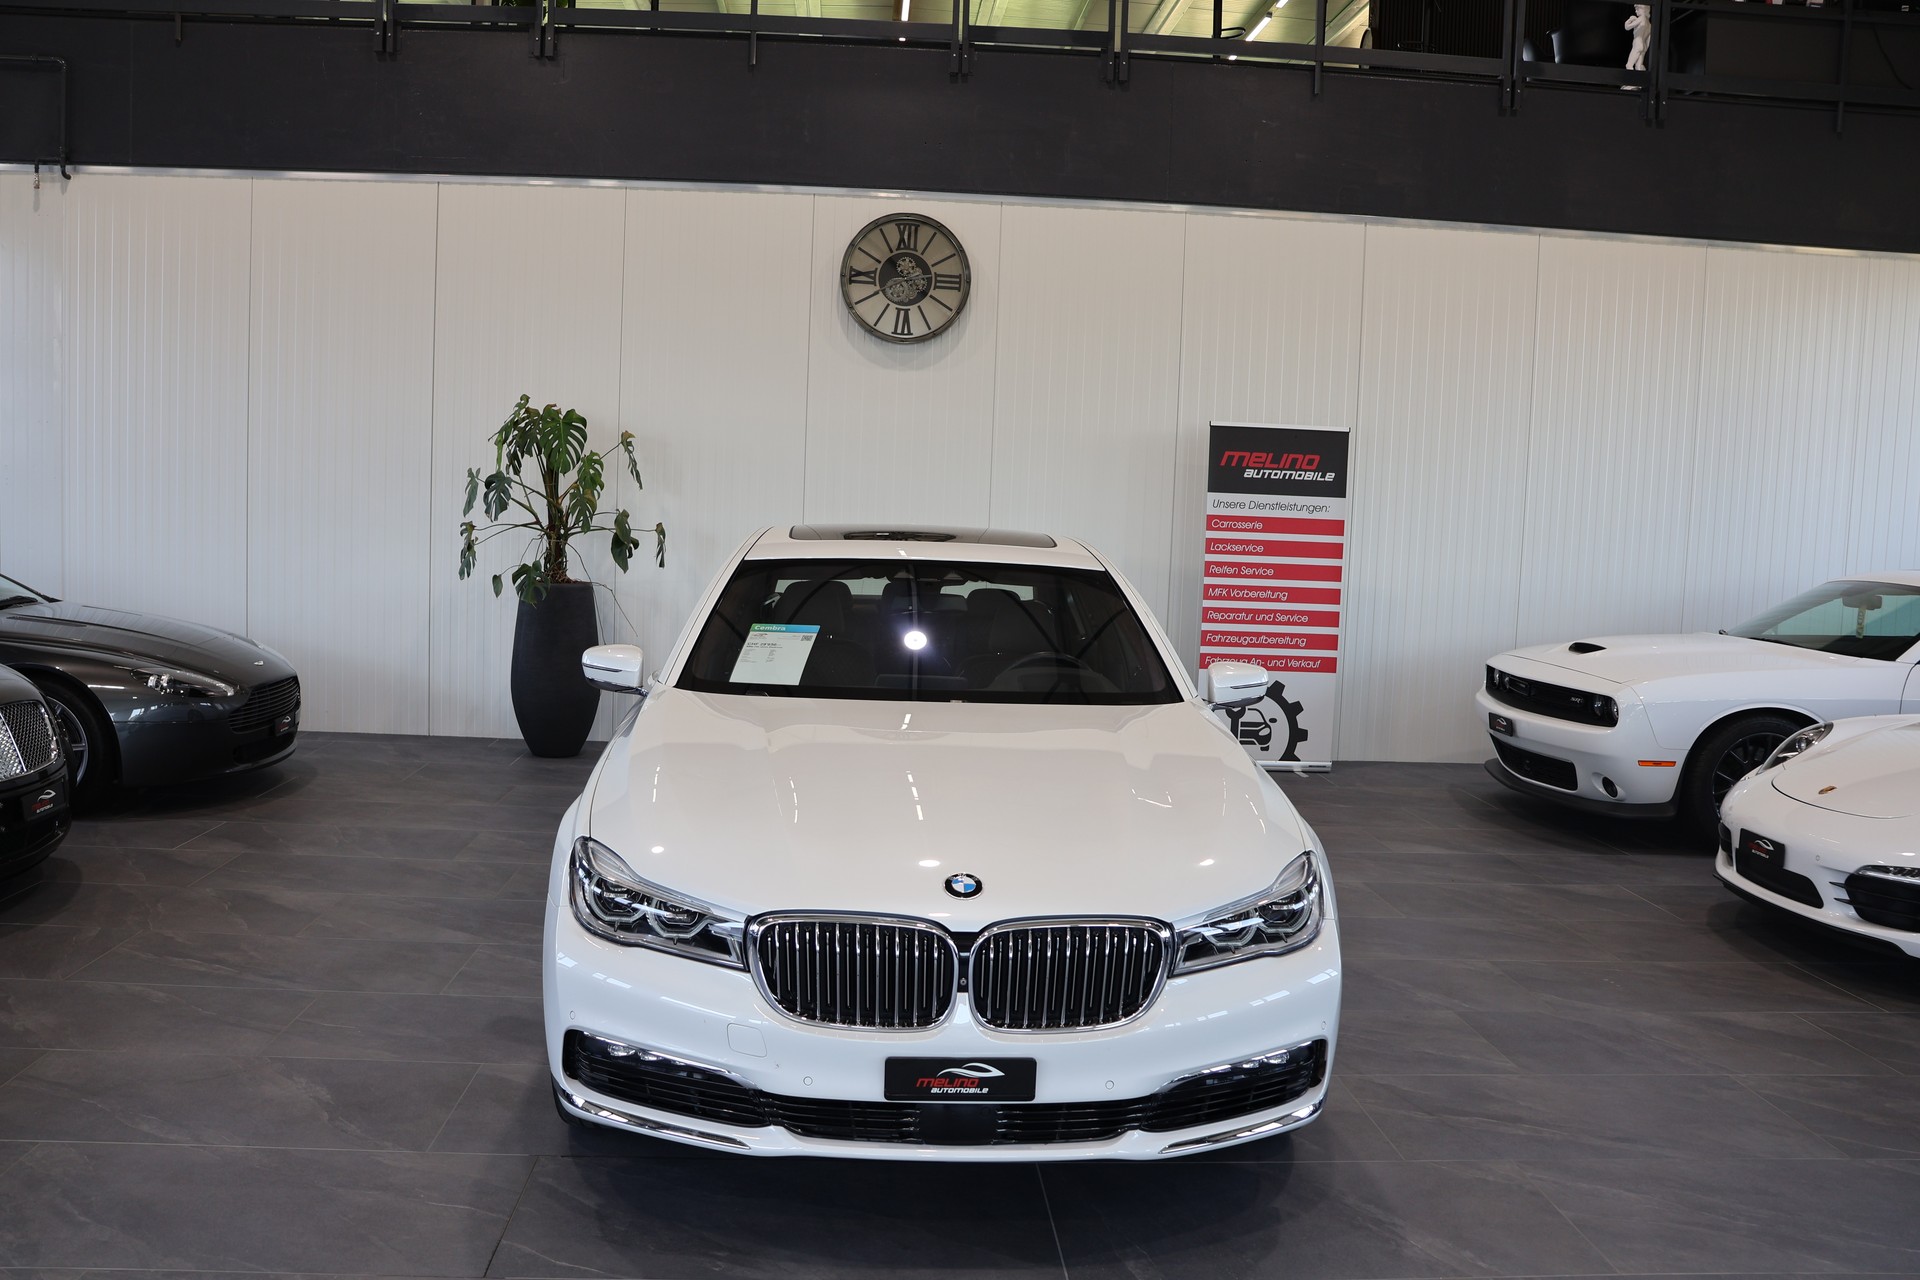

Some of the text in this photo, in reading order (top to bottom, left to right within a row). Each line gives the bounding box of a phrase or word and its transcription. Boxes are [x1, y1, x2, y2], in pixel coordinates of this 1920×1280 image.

[895, 223, 920, 252] XII
[1212, 499, 1331, 515] Unsere Dienstleistungen:
[1211, 518, 1263, 530] Carrosserie
[1210, 542, 1264, 553] Lackservice
[1209, 564, 1274, 576] Reifen Service
[1208, 588, 1288, 601] MFK Vorbereitung
[1207, 611, 1309, 623] Reparatur und Service
[1206, 633, 1307, 647] Fahrzeugaufbereitung
[1249, 657, 1264, 667] An-
[1267, 658, 1285, 668] und
[1287, 659, 1321, 669] Verkauf
